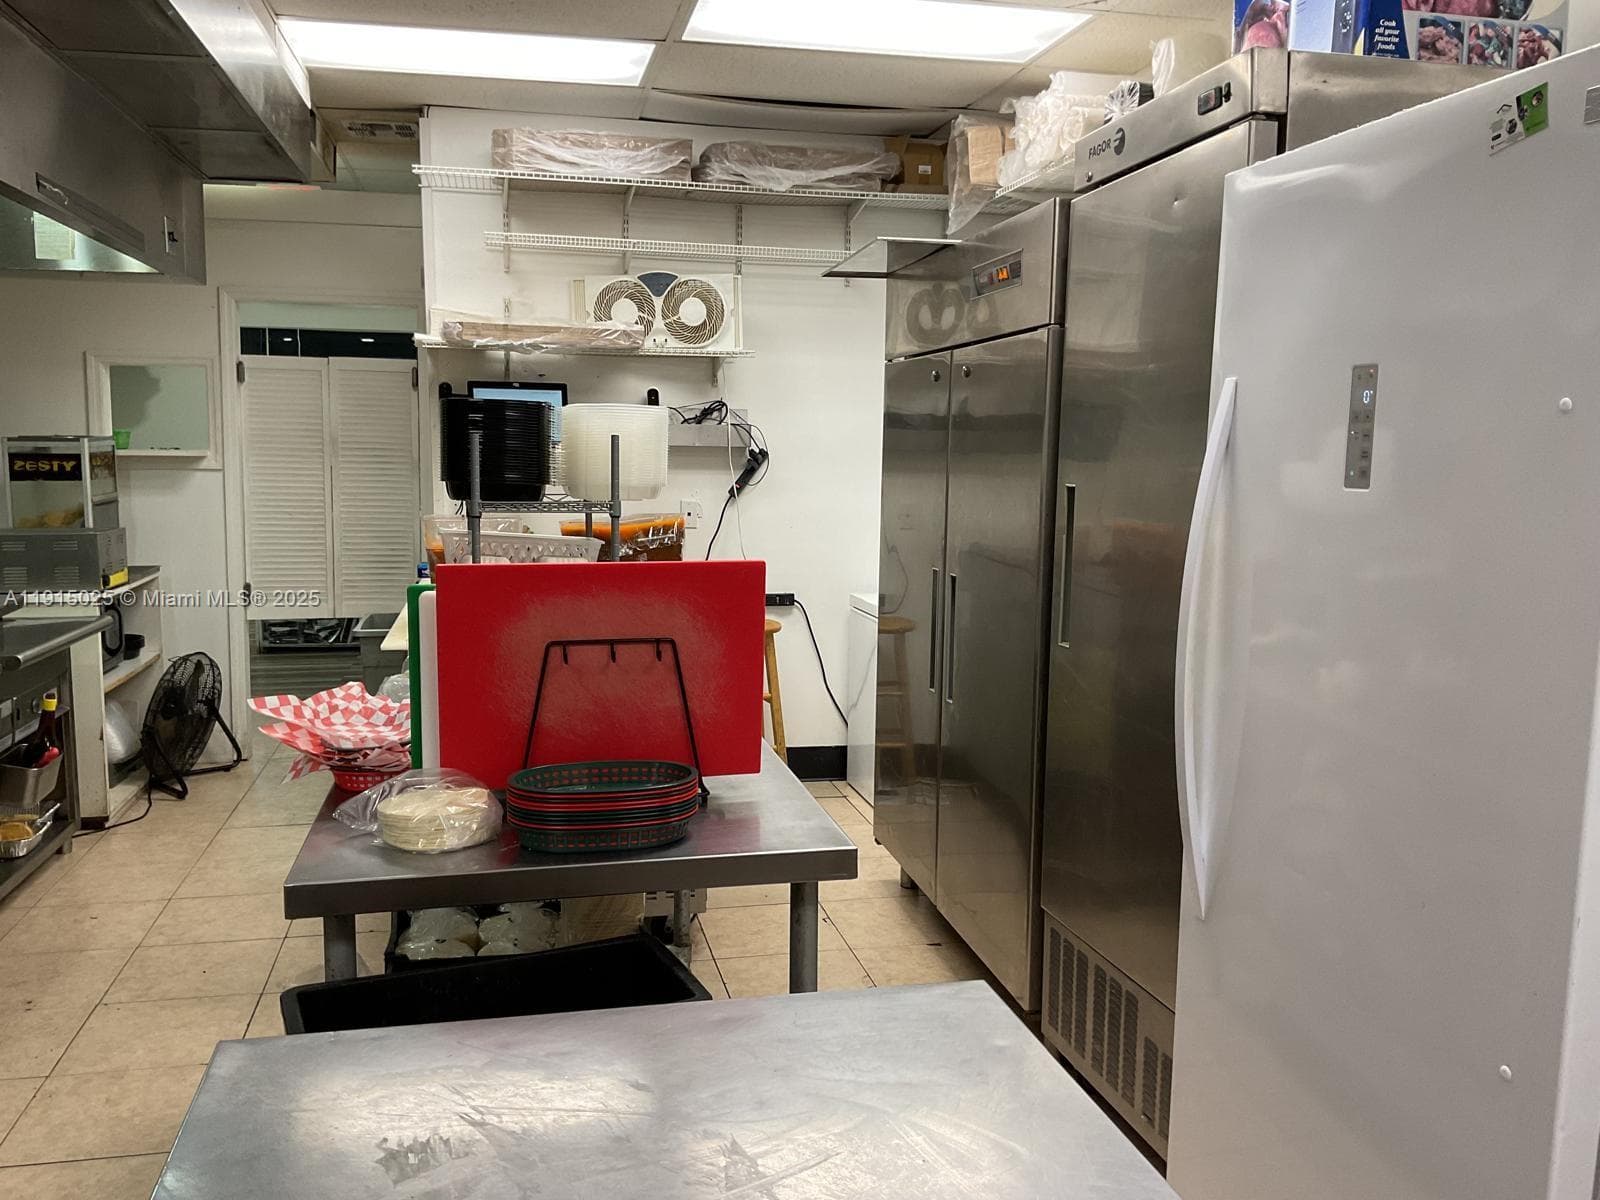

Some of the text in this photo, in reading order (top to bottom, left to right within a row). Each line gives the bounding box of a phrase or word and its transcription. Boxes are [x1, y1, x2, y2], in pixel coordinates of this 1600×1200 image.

[1380, 19, 1396, 27] Cook
[1374, 34, 1400, 43] favorite
[1377, 42, 1396, 50] foods
[1088, 138, 1112, 160] FAGOR
[13, 460, 78, 472] ZESTY
